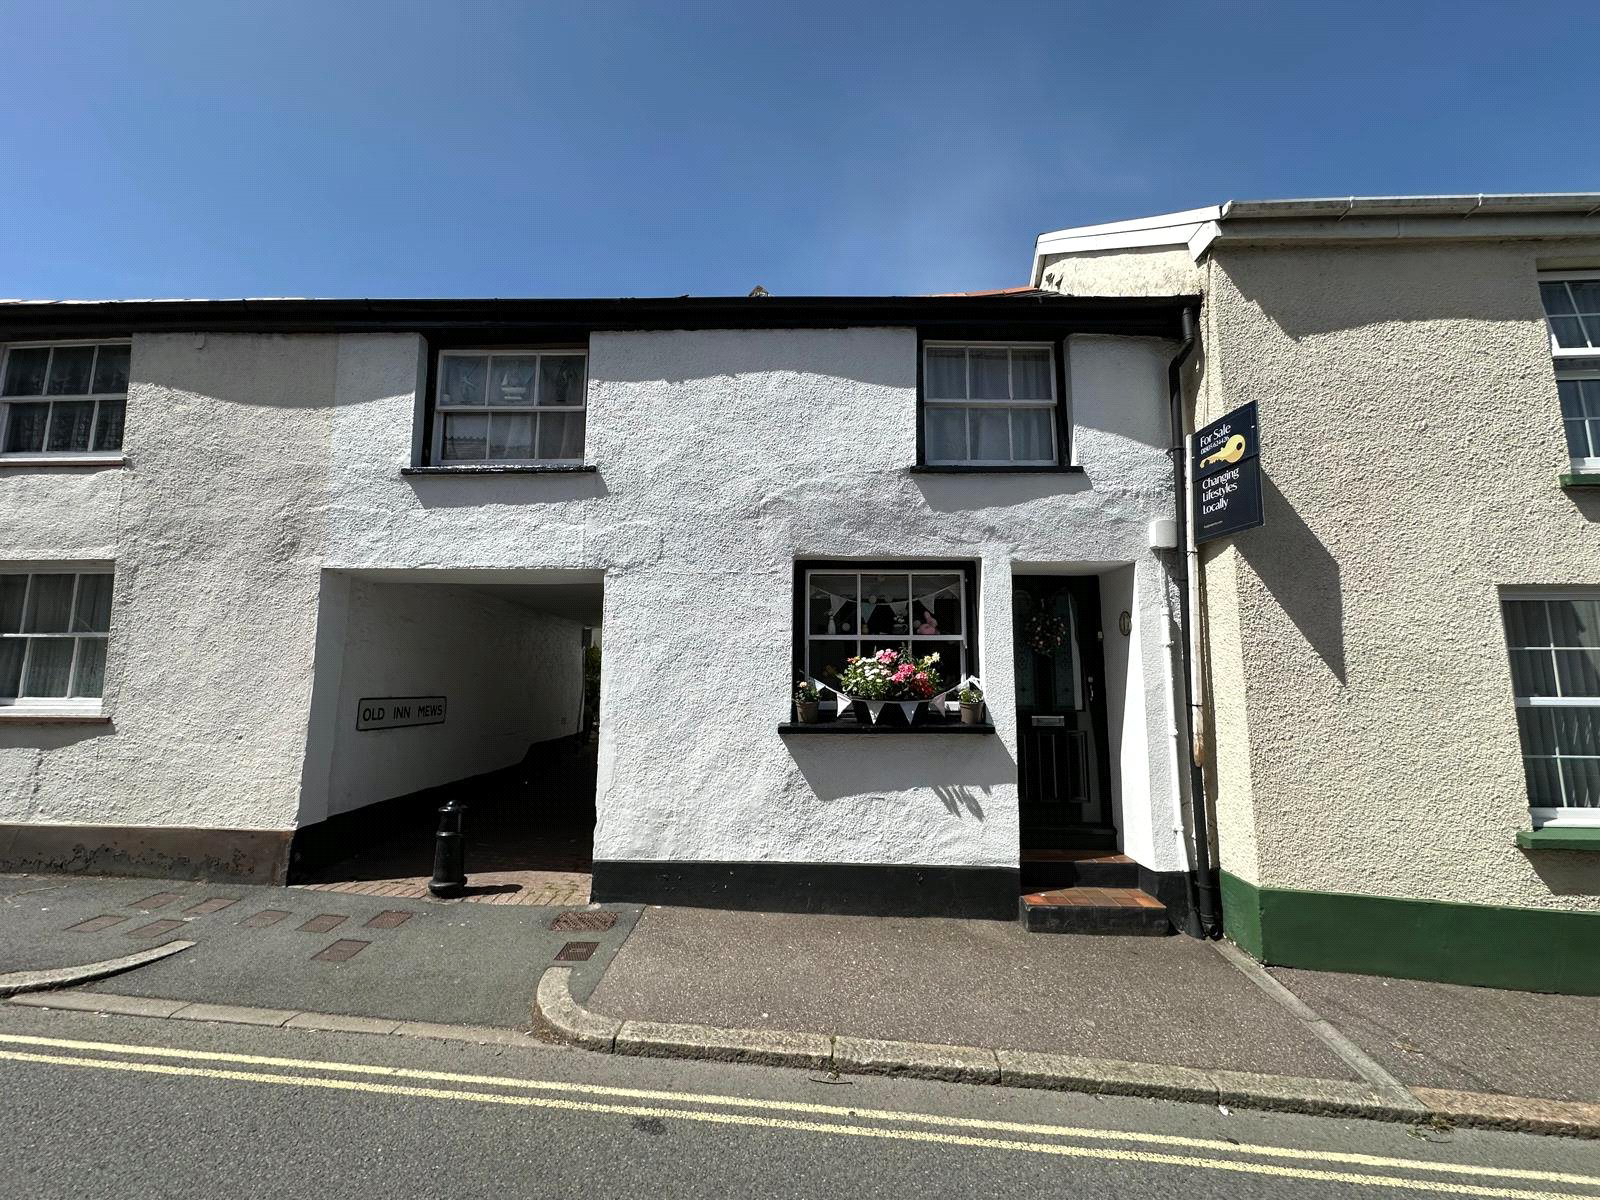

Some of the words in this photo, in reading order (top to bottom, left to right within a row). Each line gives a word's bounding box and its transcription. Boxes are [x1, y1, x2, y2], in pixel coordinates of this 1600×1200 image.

[1200, 433, 1213, 448] For
[1213, 424, 1231, 440] Sale
[1202, 467, 1240, 490] Changing
[1202, 482, 1238, 502] Lifestyles
[1202, 497, 1229, 515] Locally
[362, 707, 385, 722] OLD
[393, 705, 411, 720] INN
[417, 704, 443, 718] MEWS
